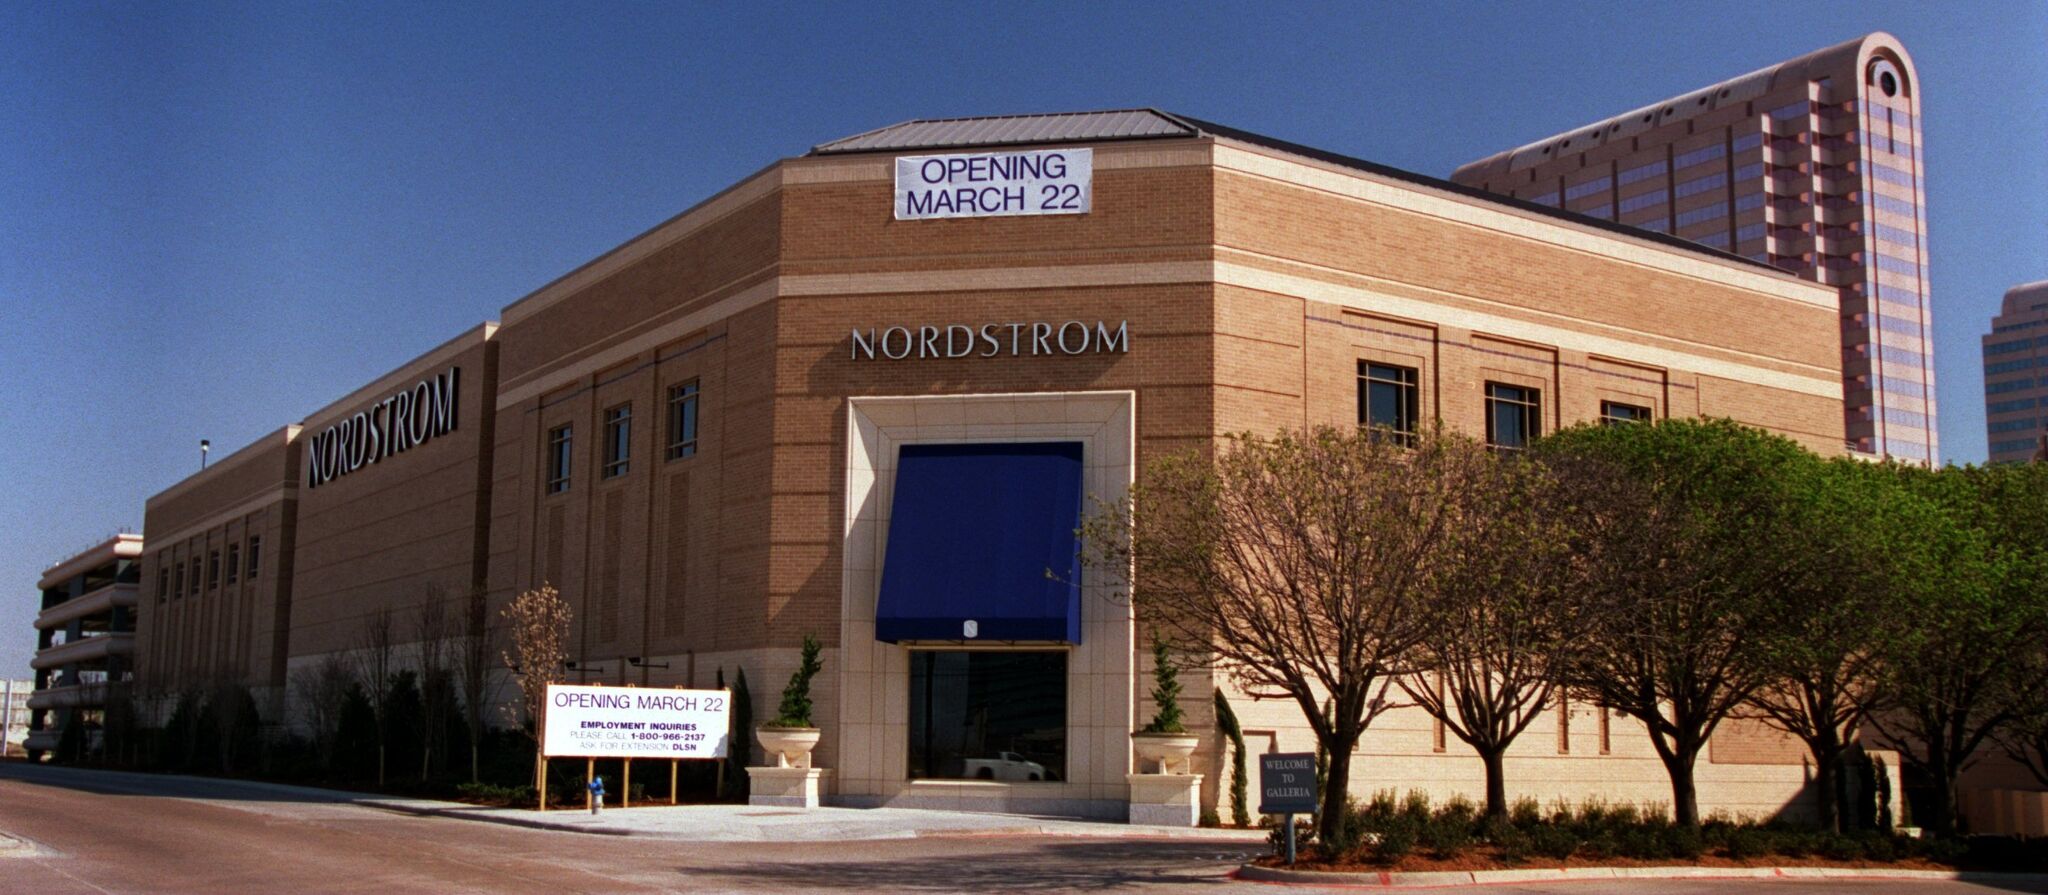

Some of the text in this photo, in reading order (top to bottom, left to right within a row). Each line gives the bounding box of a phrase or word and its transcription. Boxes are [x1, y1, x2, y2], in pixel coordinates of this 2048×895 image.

[922, 153, 1067, 184] OPENING
[907, 184, 1080, 215] MARCH 22
[851, 319, 1129, 360] NORDSTROM
[308, 367, 459, 488] NORDSTROM
[554, 692, 723, 712] OPENING MARCH 22
[580, 721, 697, 731] EMPLOYMENT INQUIRIES
[570, 731, 705, 741] PLEASE CALL 1-800-966-2137
[579, 741, 697, 751] ASK FOR EXTENSION DLSN
[1265, 759, 1310, 769] WELCOME
[1282, 774, 1295, 783] TO
[1266, 787, 1311, 797] GALLERIA
